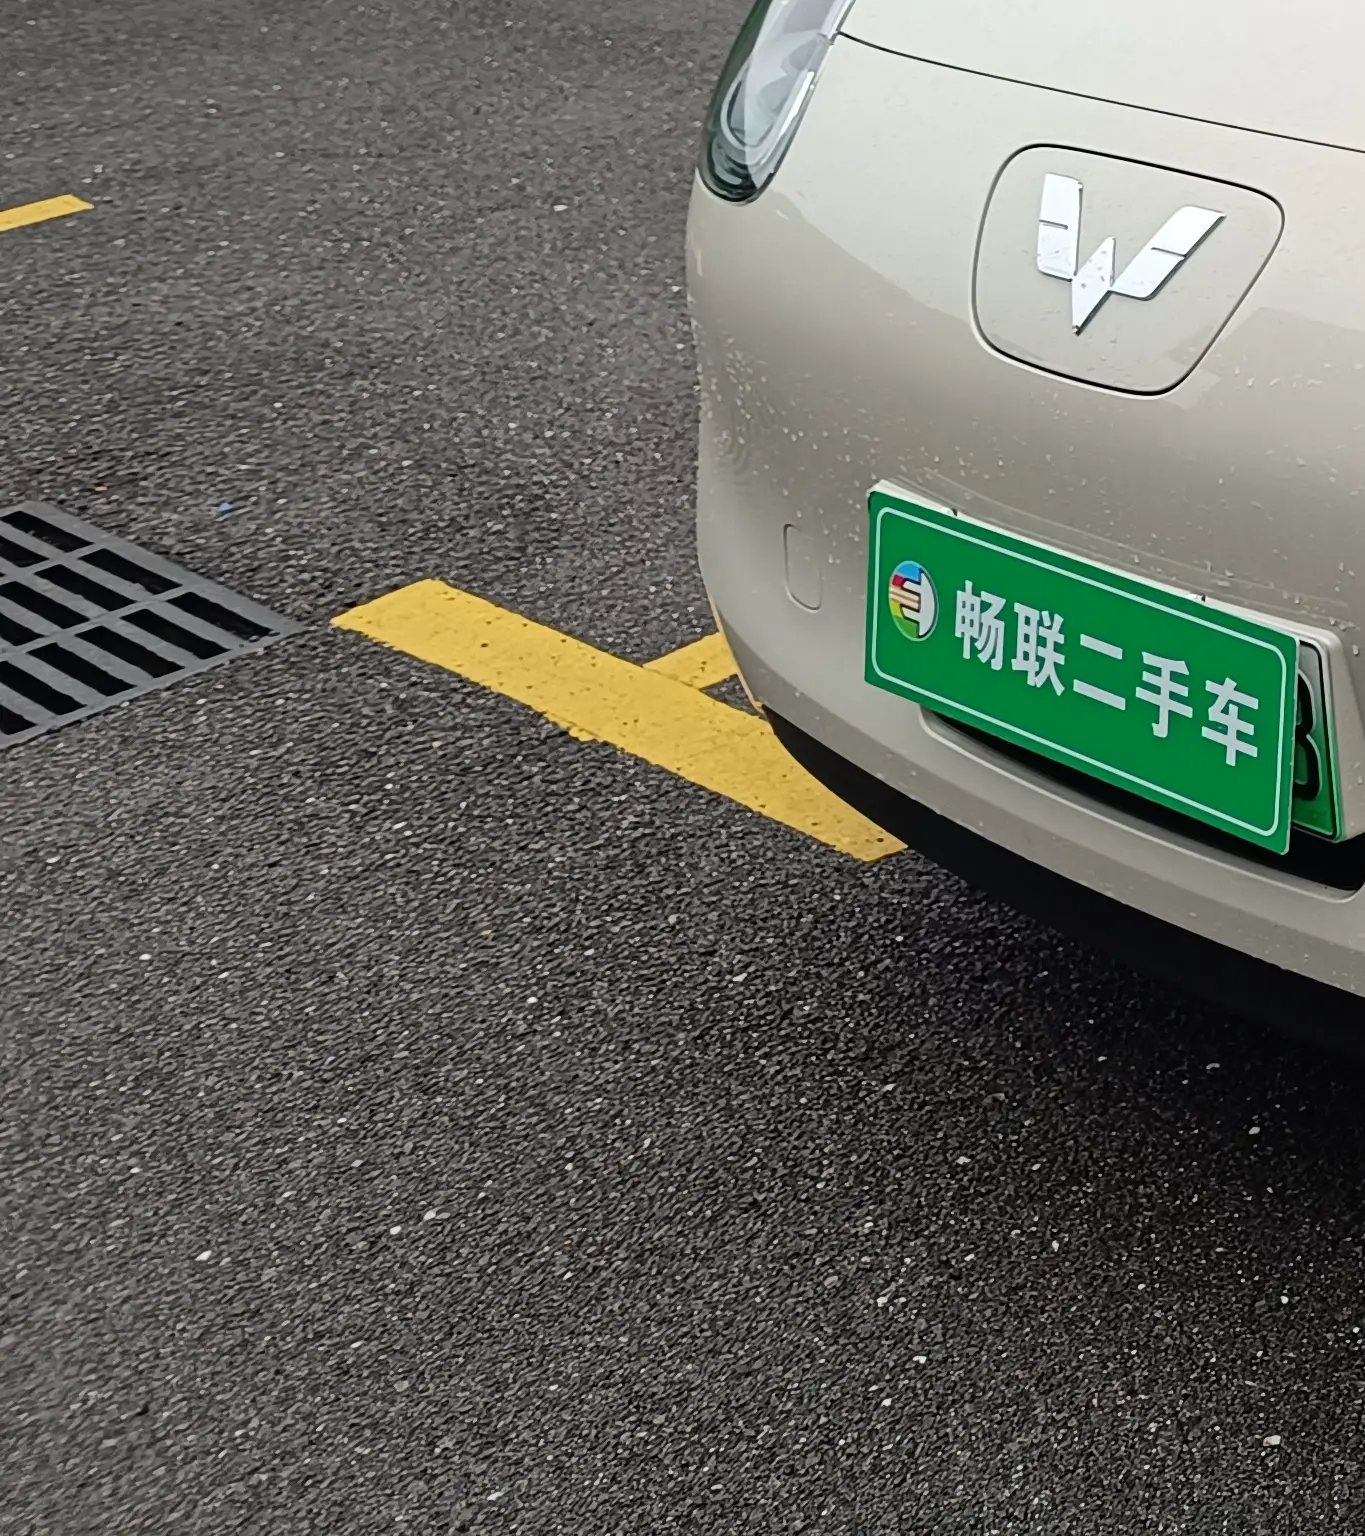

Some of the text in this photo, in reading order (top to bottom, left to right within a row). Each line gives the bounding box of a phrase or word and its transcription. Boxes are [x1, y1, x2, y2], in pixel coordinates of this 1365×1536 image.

[954, 580, 1260, 768] 畅联二手车
